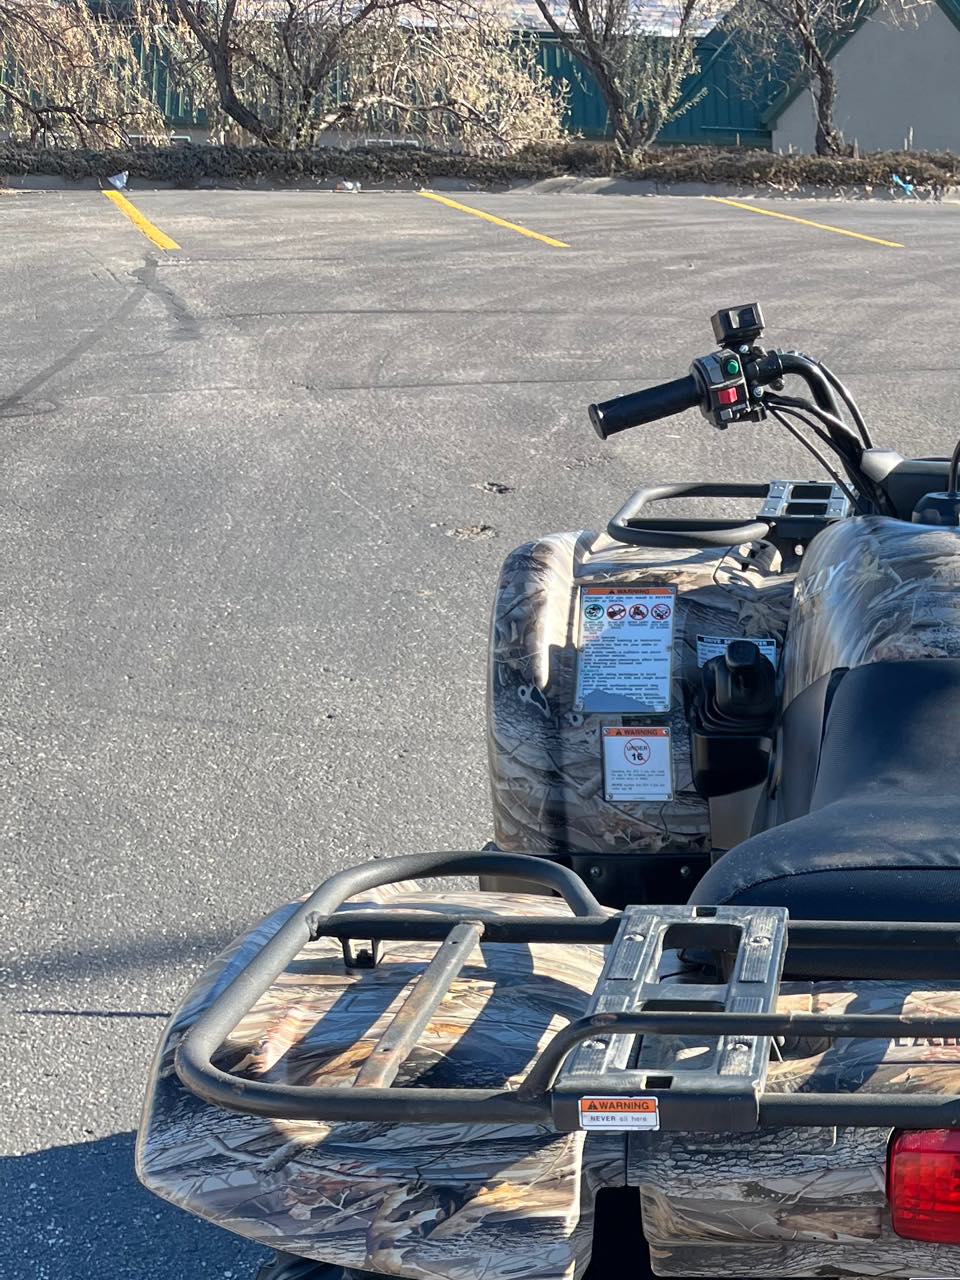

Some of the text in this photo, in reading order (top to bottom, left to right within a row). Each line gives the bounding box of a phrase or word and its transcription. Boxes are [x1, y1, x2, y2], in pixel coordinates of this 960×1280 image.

[624, 729, 658, 737] WARNING
[631, 753, 644, 761] 16
[599, 1101, 649, 1110] WARNING
